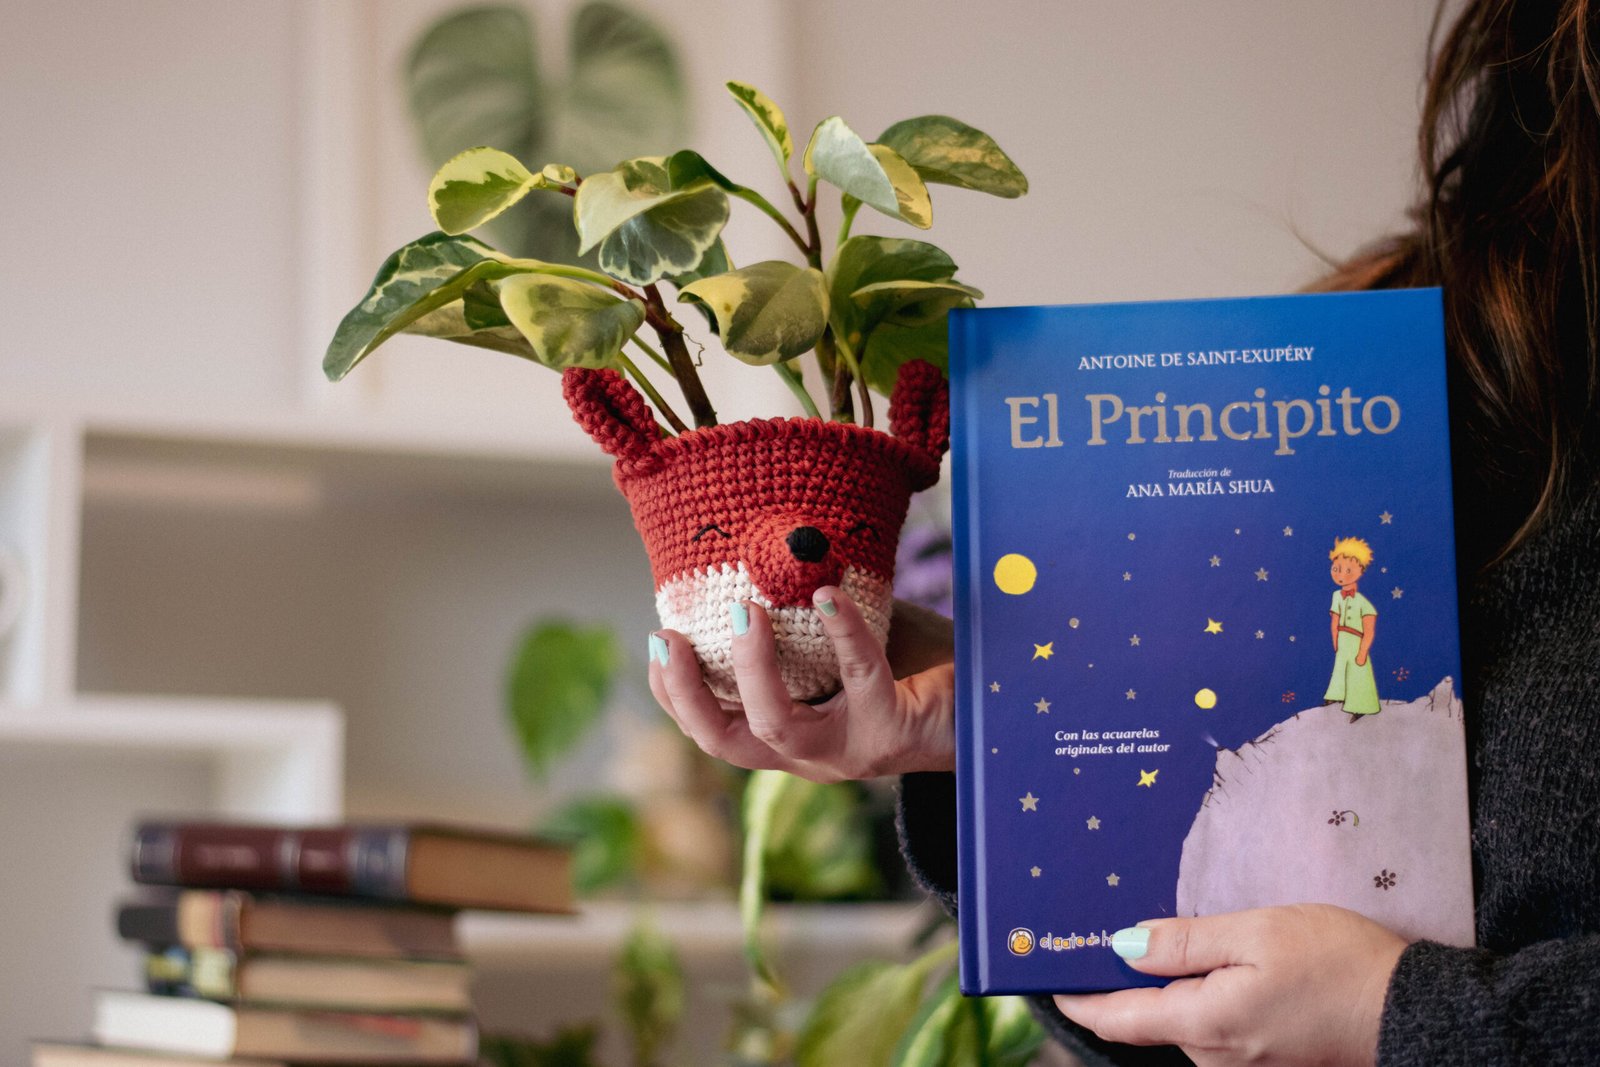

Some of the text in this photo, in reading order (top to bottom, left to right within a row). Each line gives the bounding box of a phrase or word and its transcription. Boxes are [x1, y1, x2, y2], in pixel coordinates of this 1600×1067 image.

[1078, 345, 1314, 370] ANTOINE DE SAINT-EXUPÉRY
[1004, 384, 1401, 456] El Principito
[1168, 467, 1231, 479] Traducción de
[1126, 478, 1274, 498] ANA MARÍA SHUA
[1055, 728, 1160, 741] Con las acuarelas
[1055, 742, 1170, 758] originales del autor
[1053, 932, 1085, 951] gato
